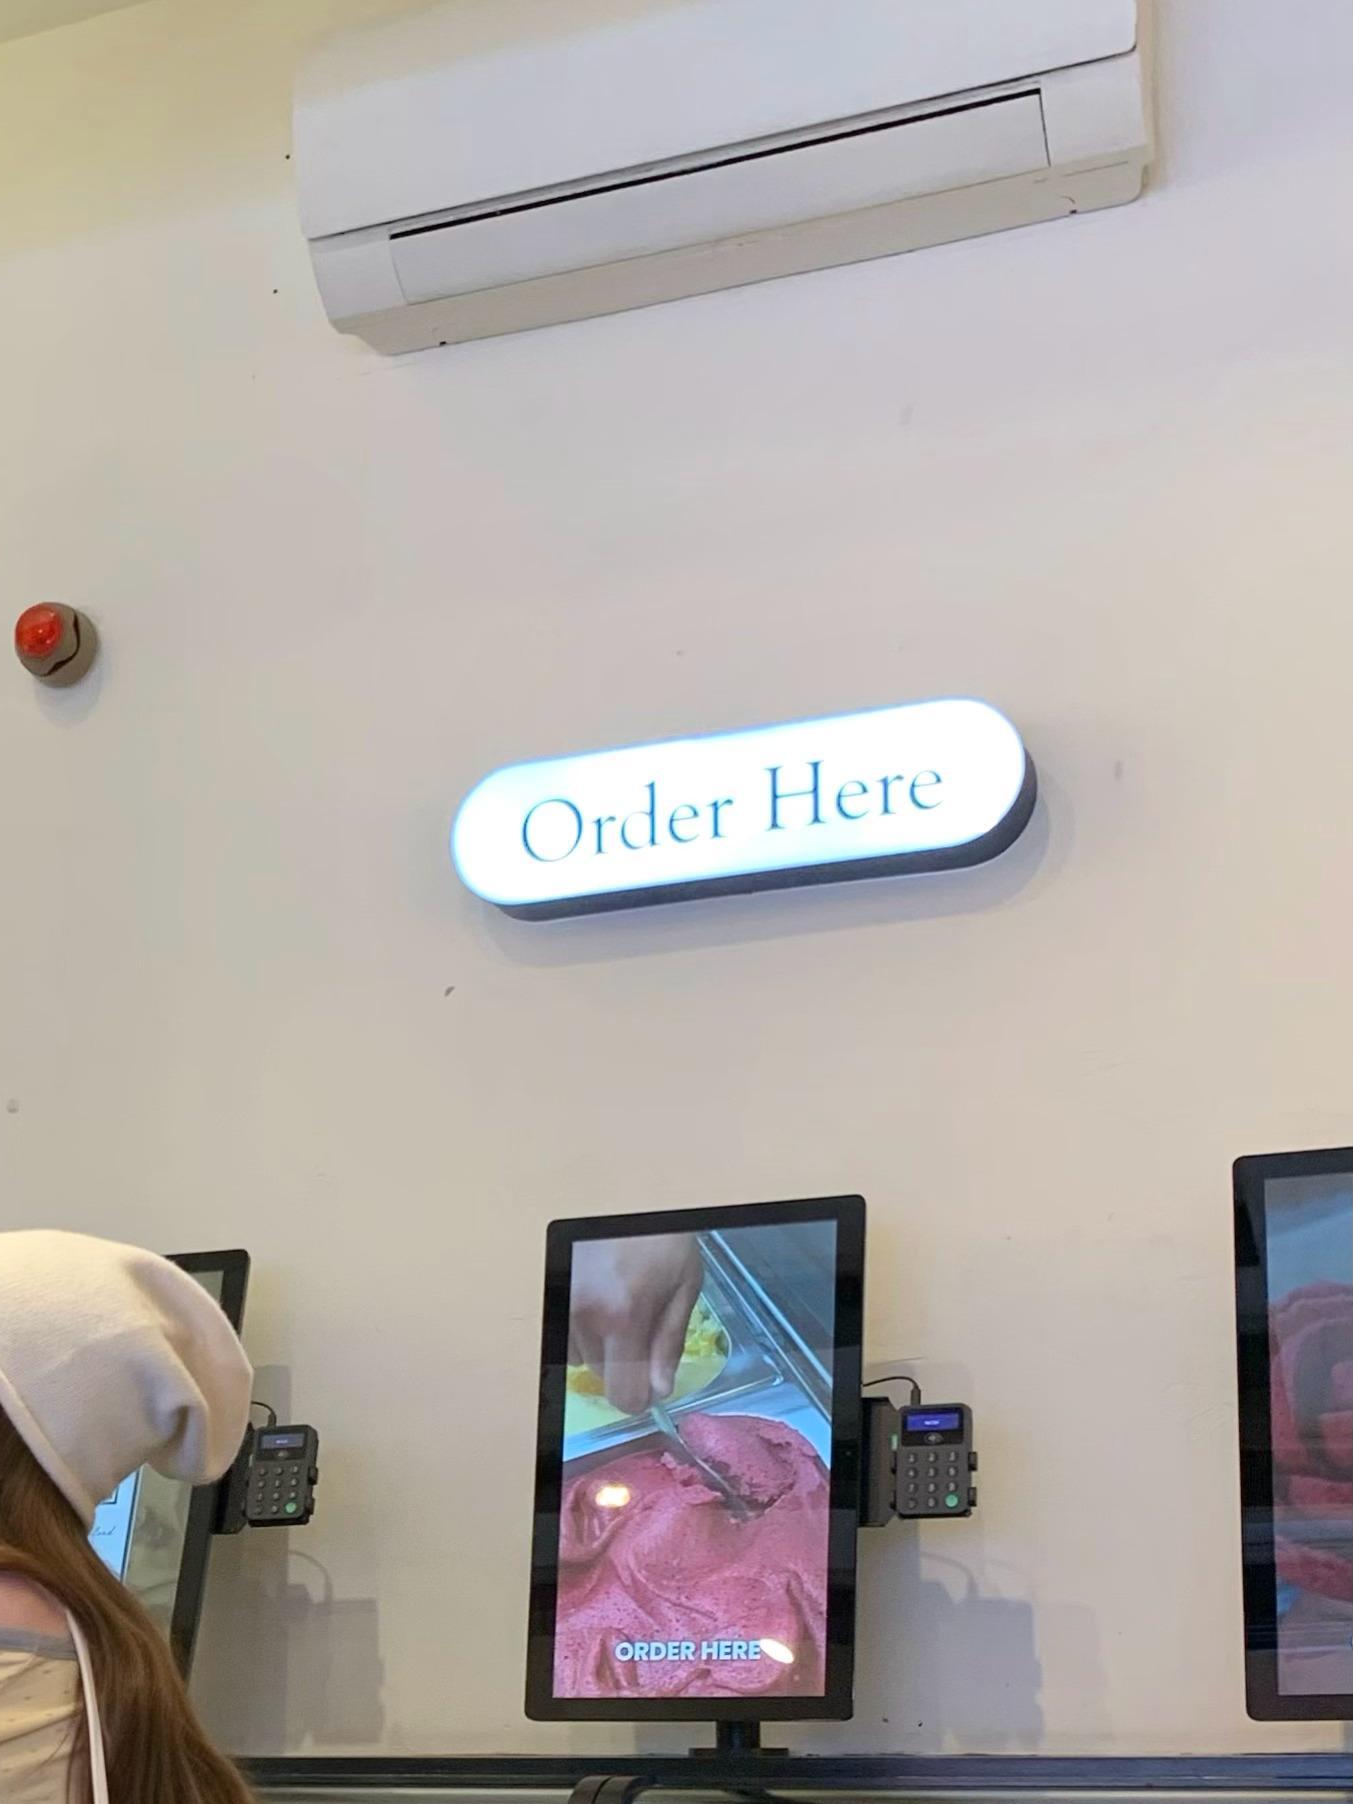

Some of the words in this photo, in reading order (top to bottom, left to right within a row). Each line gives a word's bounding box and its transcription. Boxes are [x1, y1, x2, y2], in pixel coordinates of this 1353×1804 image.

[522, 781, 733, 862] Order
[764, 760, 943, 832] Here
[615, 1641, 696, 1662] ORDER
[701, 1640, 761, 1661] HERE
